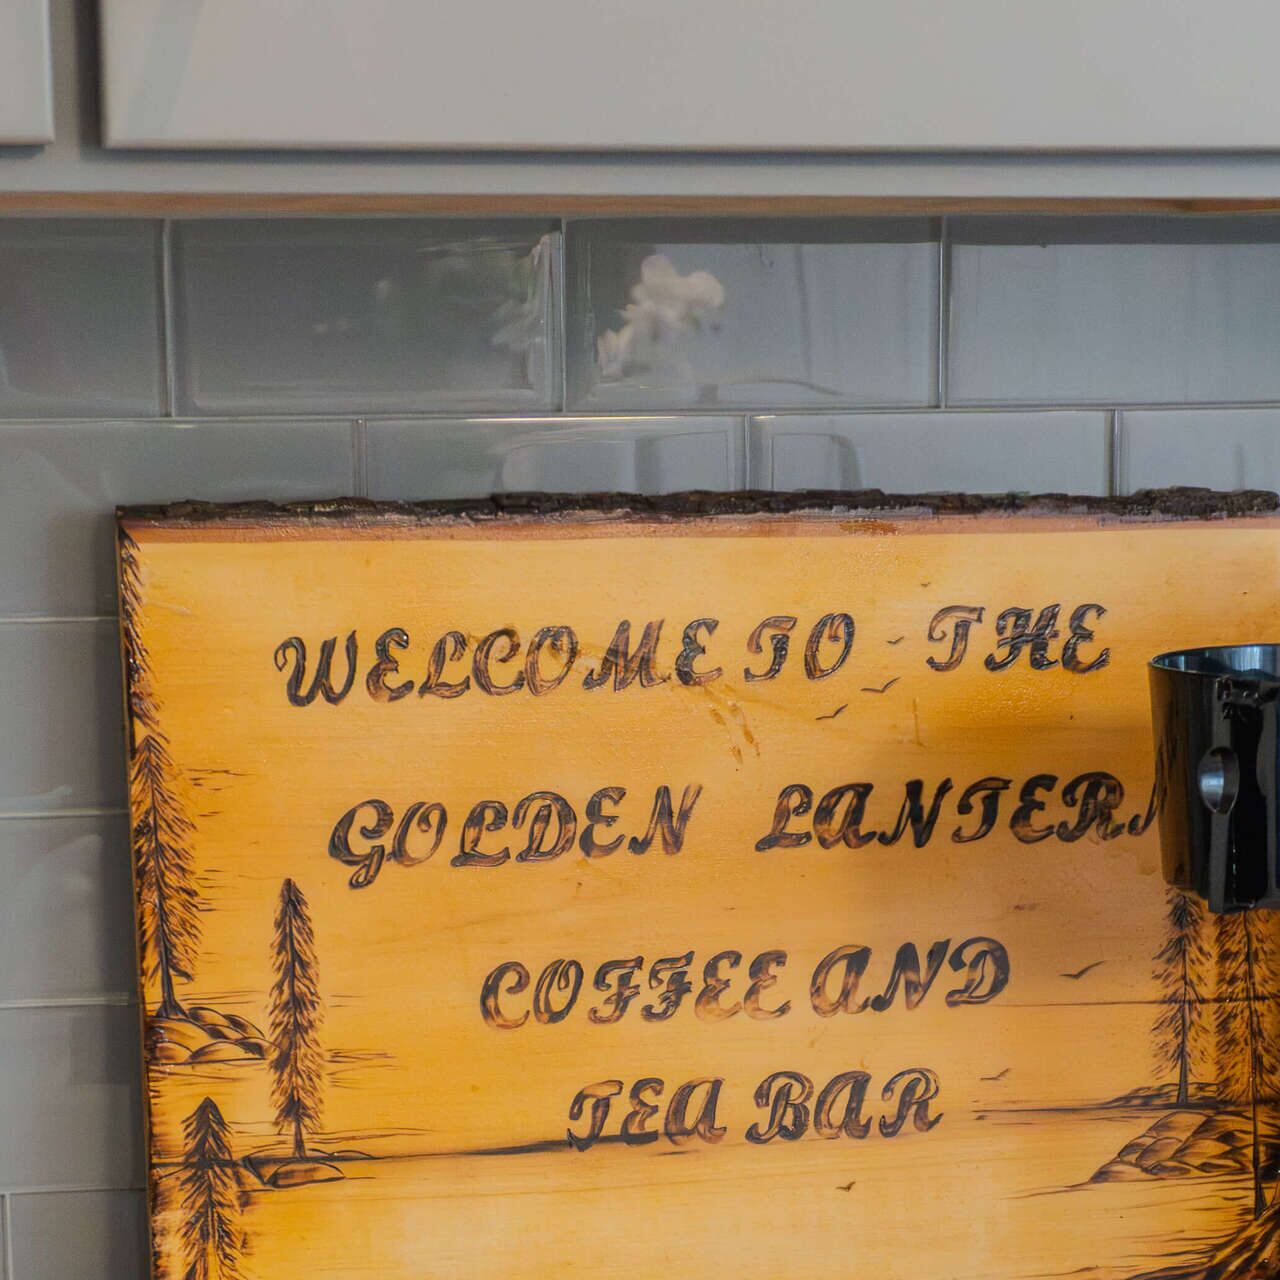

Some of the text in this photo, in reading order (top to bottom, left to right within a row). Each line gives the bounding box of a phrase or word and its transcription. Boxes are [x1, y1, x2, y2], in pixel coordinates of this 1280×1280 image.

[274, 602, 1112, 707] WELCOME TO THE
[328, 783, 704, 890] GOLDEN
[479, 935, 1011, 1032] COFFEE AND
[566, 1067, 943, 1154] TEA BAR
